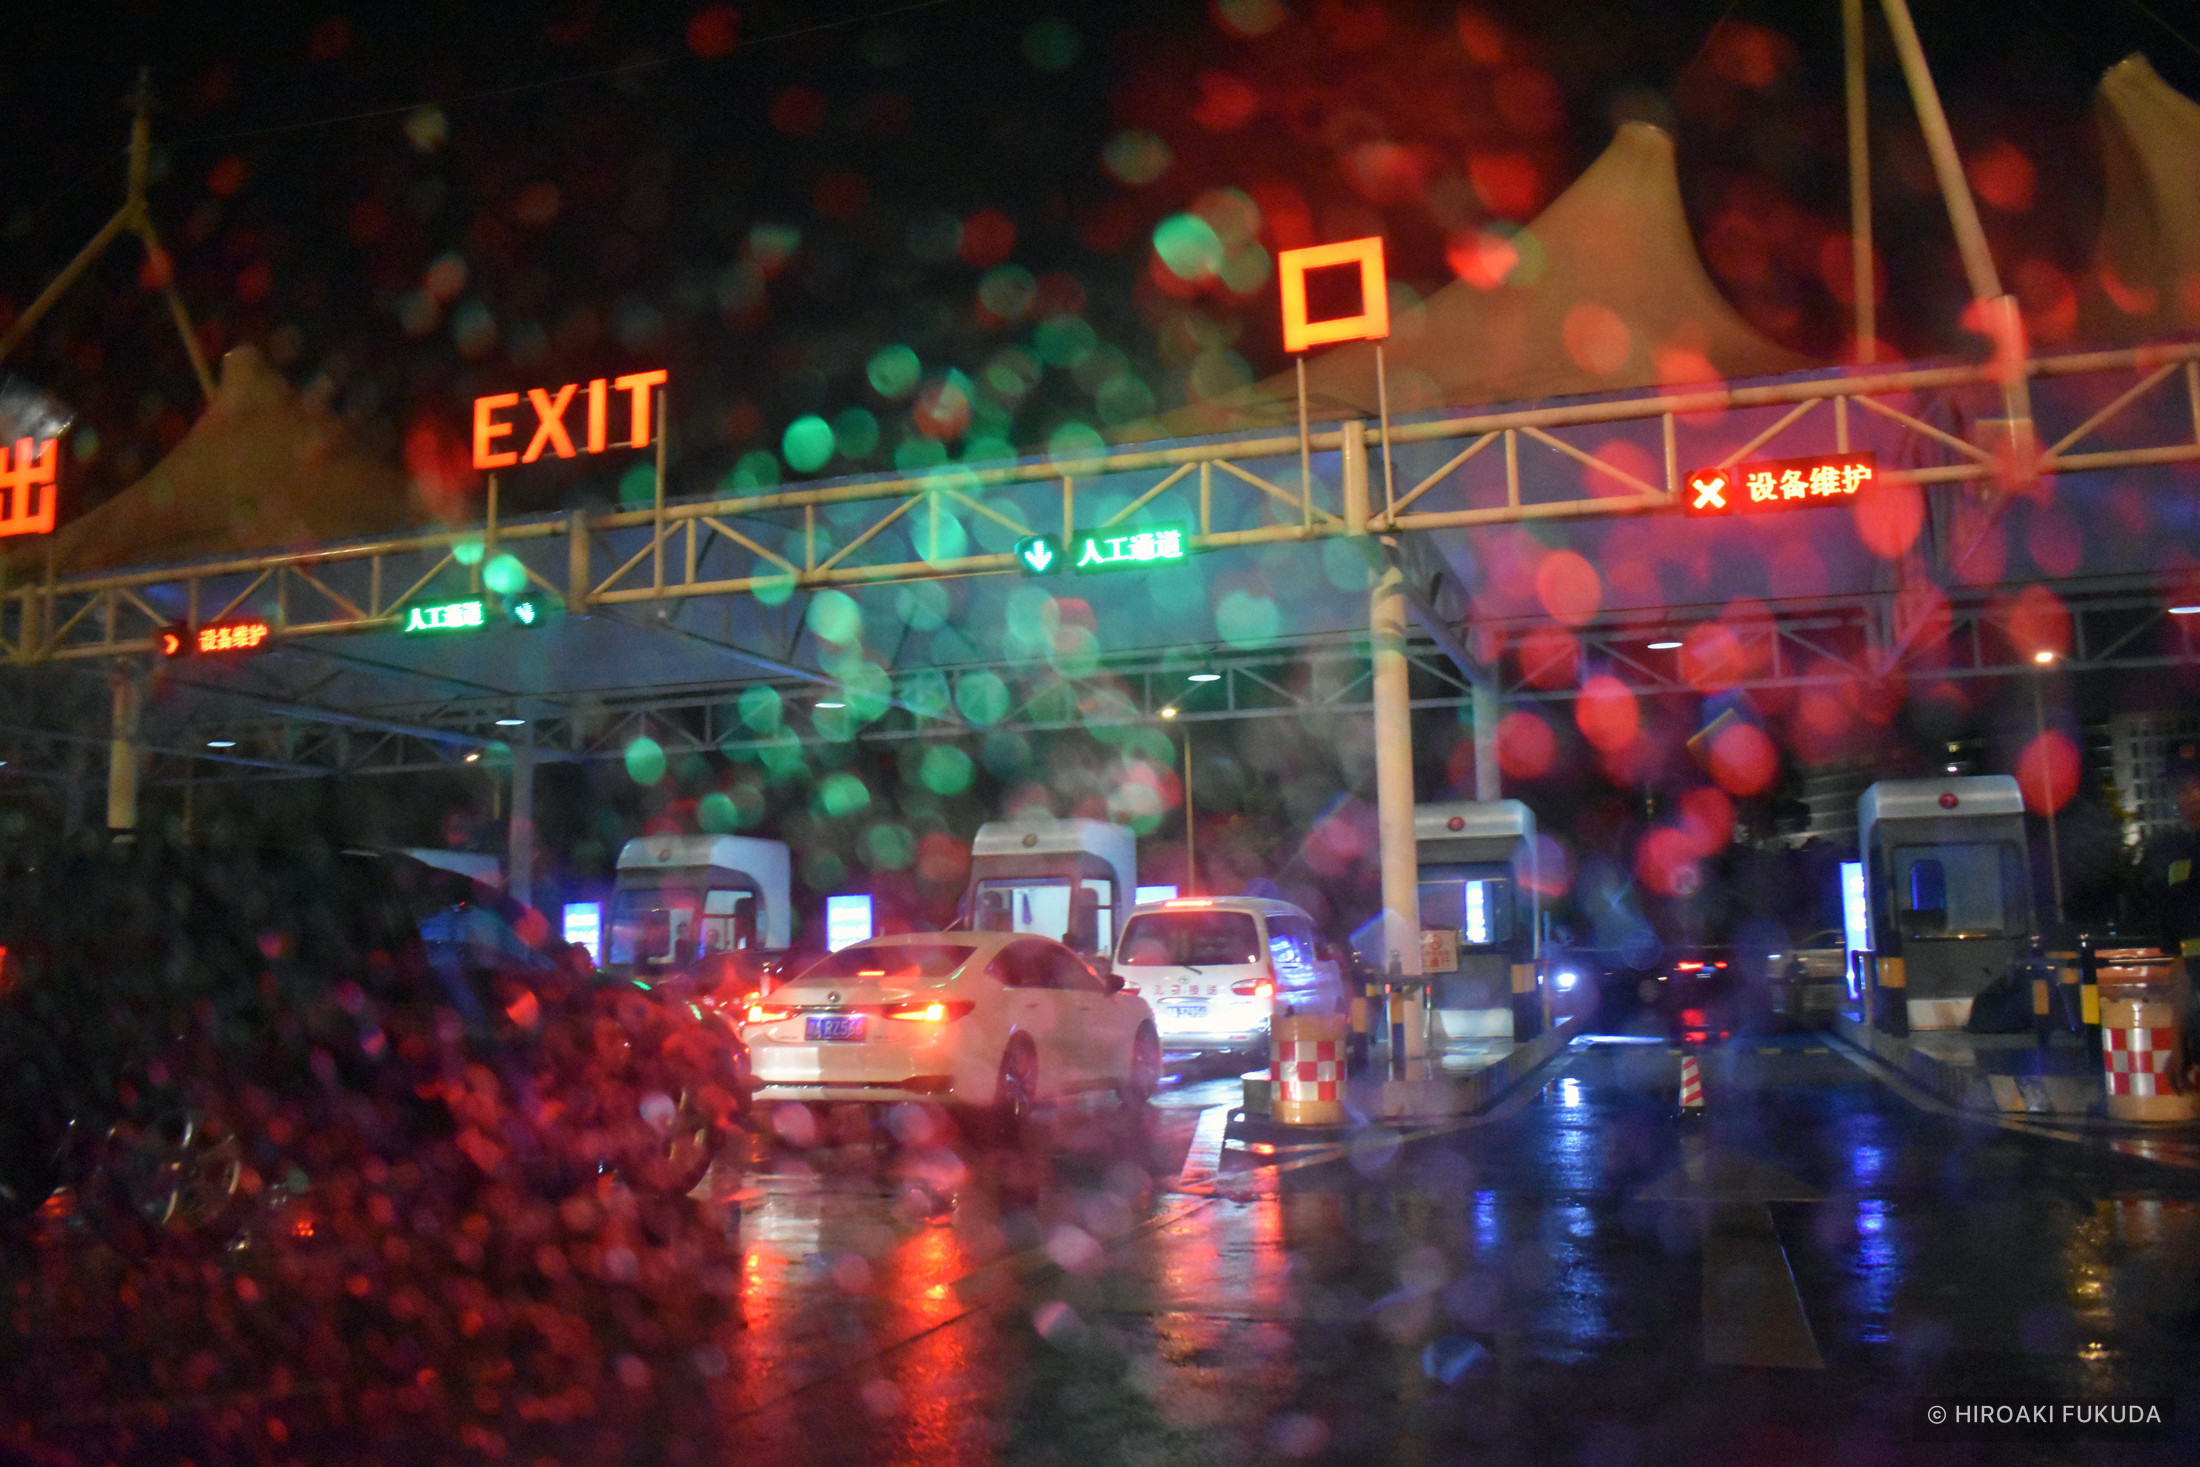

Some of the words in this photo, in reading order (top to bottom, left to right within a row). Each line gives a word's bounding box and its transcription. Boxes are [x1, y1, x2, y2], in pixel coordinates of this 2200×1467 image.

[1278, 235, 1390, 353] 口
[473, 369, 668, 469] EXIT
[0, 436, 58, 537] 出
[1746, 464, 1872, 502] 设备维护
[1077, 530, 1183, 566] 人工通道
